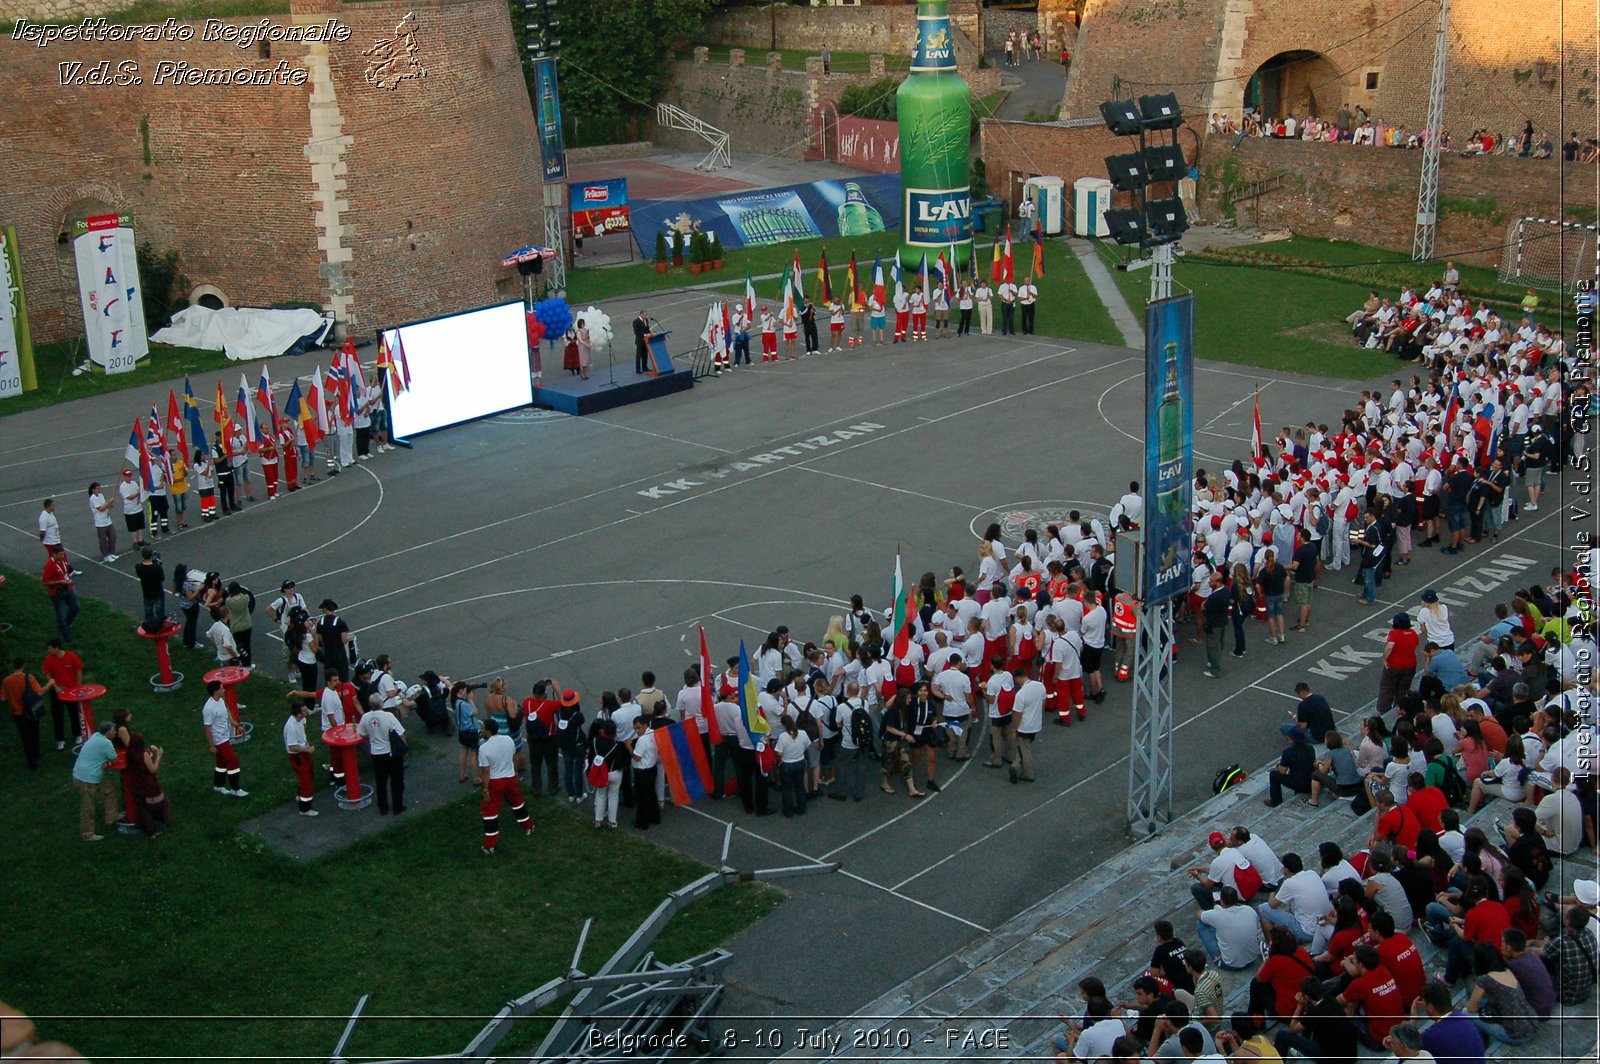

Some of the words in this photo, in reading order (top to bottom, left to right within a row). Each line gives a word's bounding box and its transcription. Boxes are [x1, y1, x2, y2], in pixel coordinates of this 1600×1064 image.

[925, 49, 949, 59] LAV
[918, 198, 970, 222] LAV
[109, 354, 134, 369] 2010
[1158, 462, 1182, 482] LAV
[636, 477, 704, 499] KK
[1155, 562, 1182, 587] LAV
[1307, 645, 1383, 681] KK
